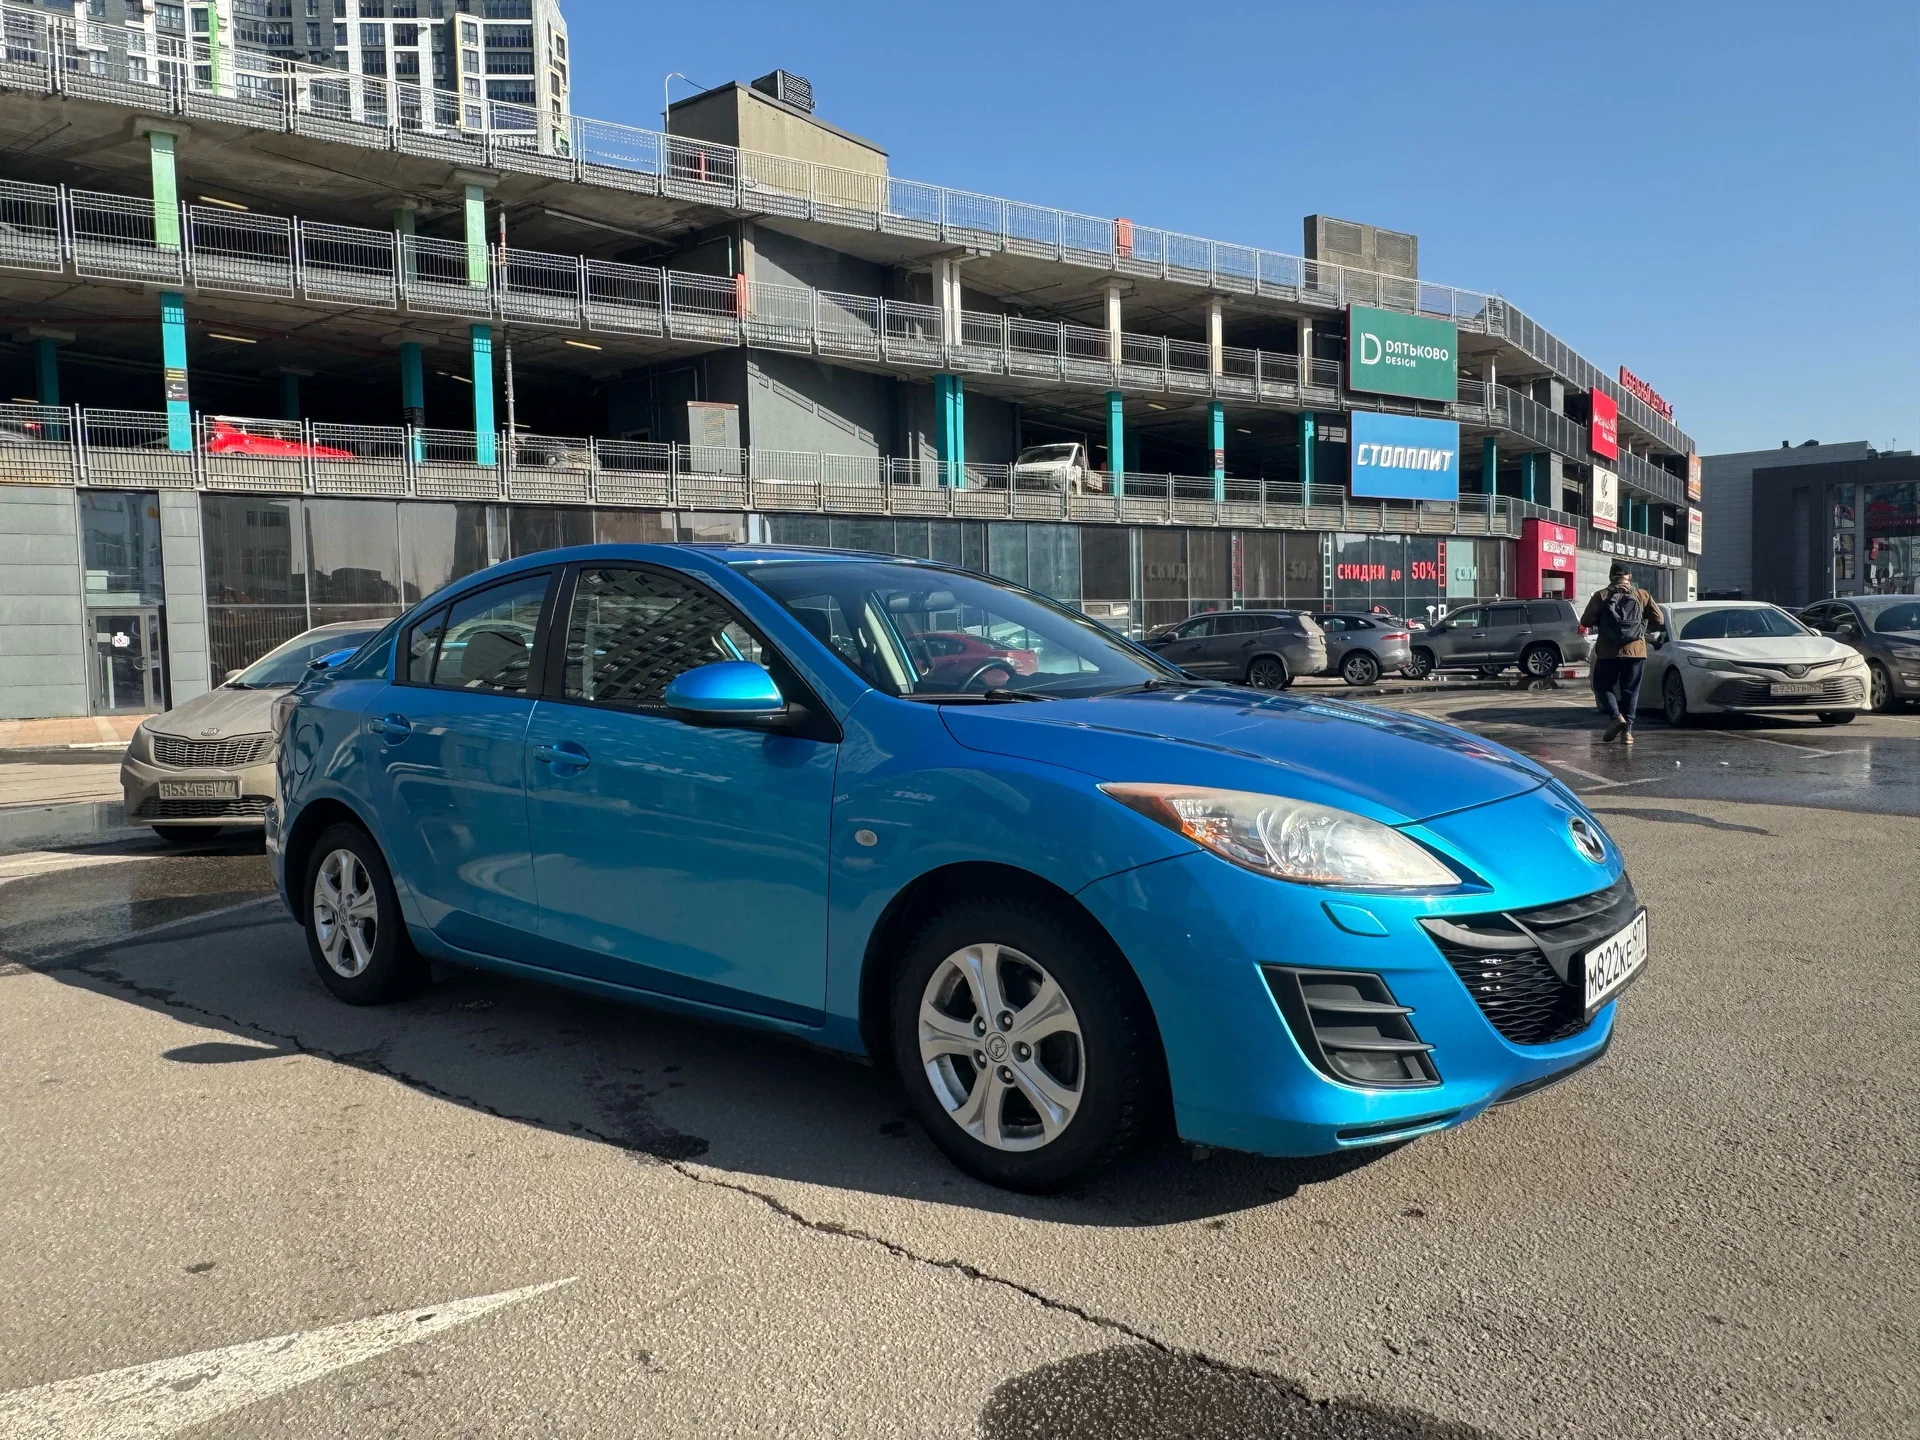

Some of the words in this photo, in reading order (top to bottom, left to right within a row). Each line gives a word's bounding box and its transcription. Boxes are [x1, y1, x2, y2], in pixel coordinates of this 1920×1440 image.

[1385, 355, 1416, 368] DESIGN
[1337, 563, 1386, 582] СКИДКИ
[1411, 561, 1436, 580] 50%
